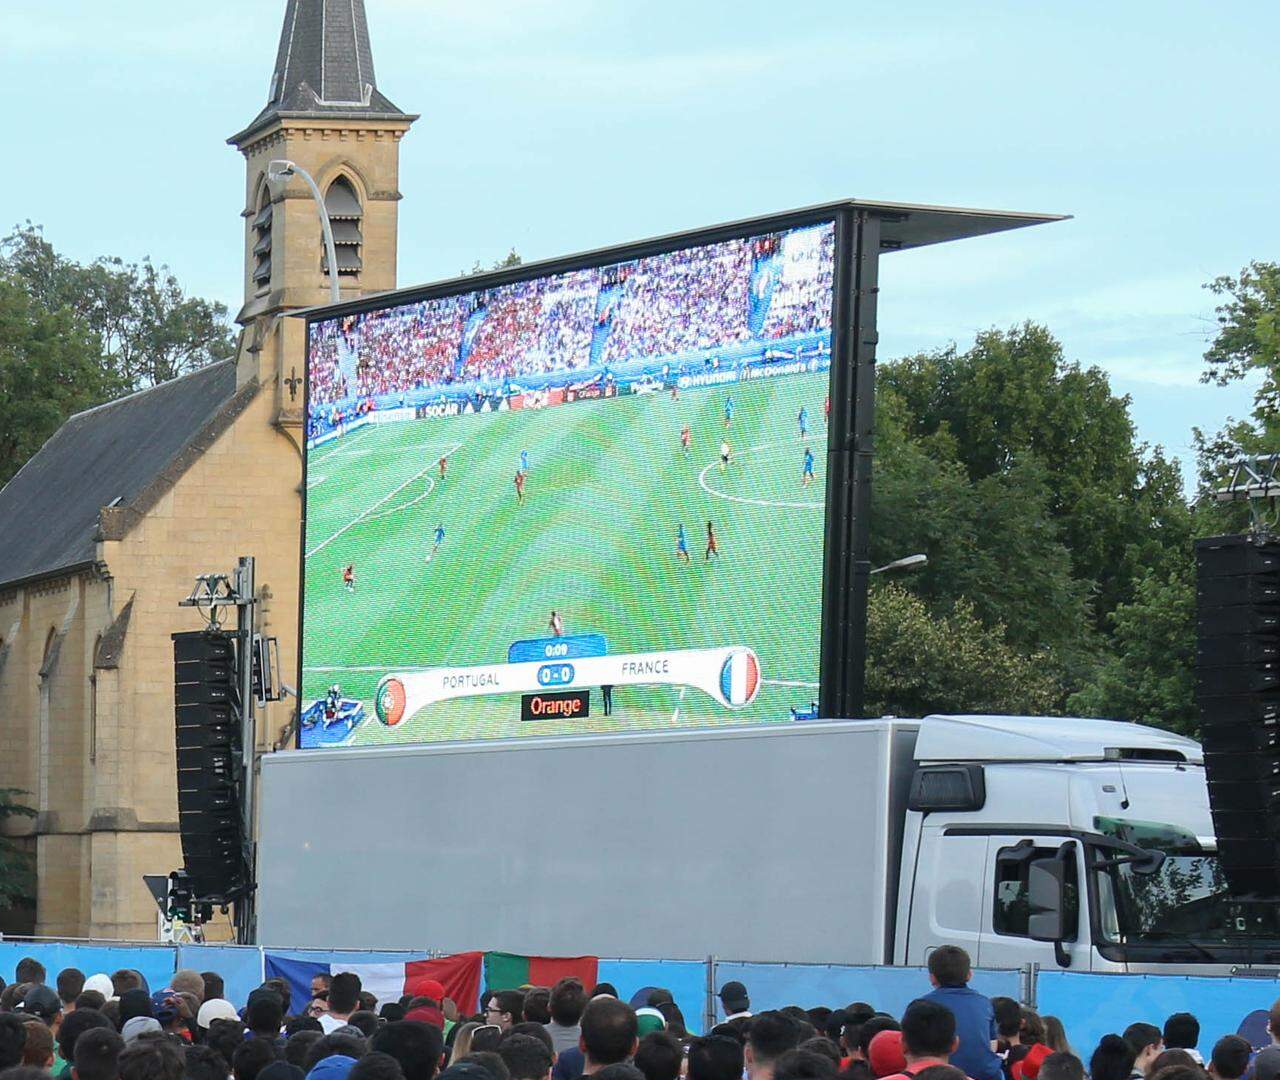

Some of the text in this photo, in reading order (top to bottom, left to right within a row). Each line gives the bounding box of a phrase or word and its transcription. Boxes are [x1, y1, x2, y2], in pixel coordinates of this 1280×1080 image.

[425, 402, 459, 417] SOCAR
[621, 659, 670, 676] FRANCE
[442, 673, 500, 689] PORTUGAL
[530, 695, 582, 717] Orange
